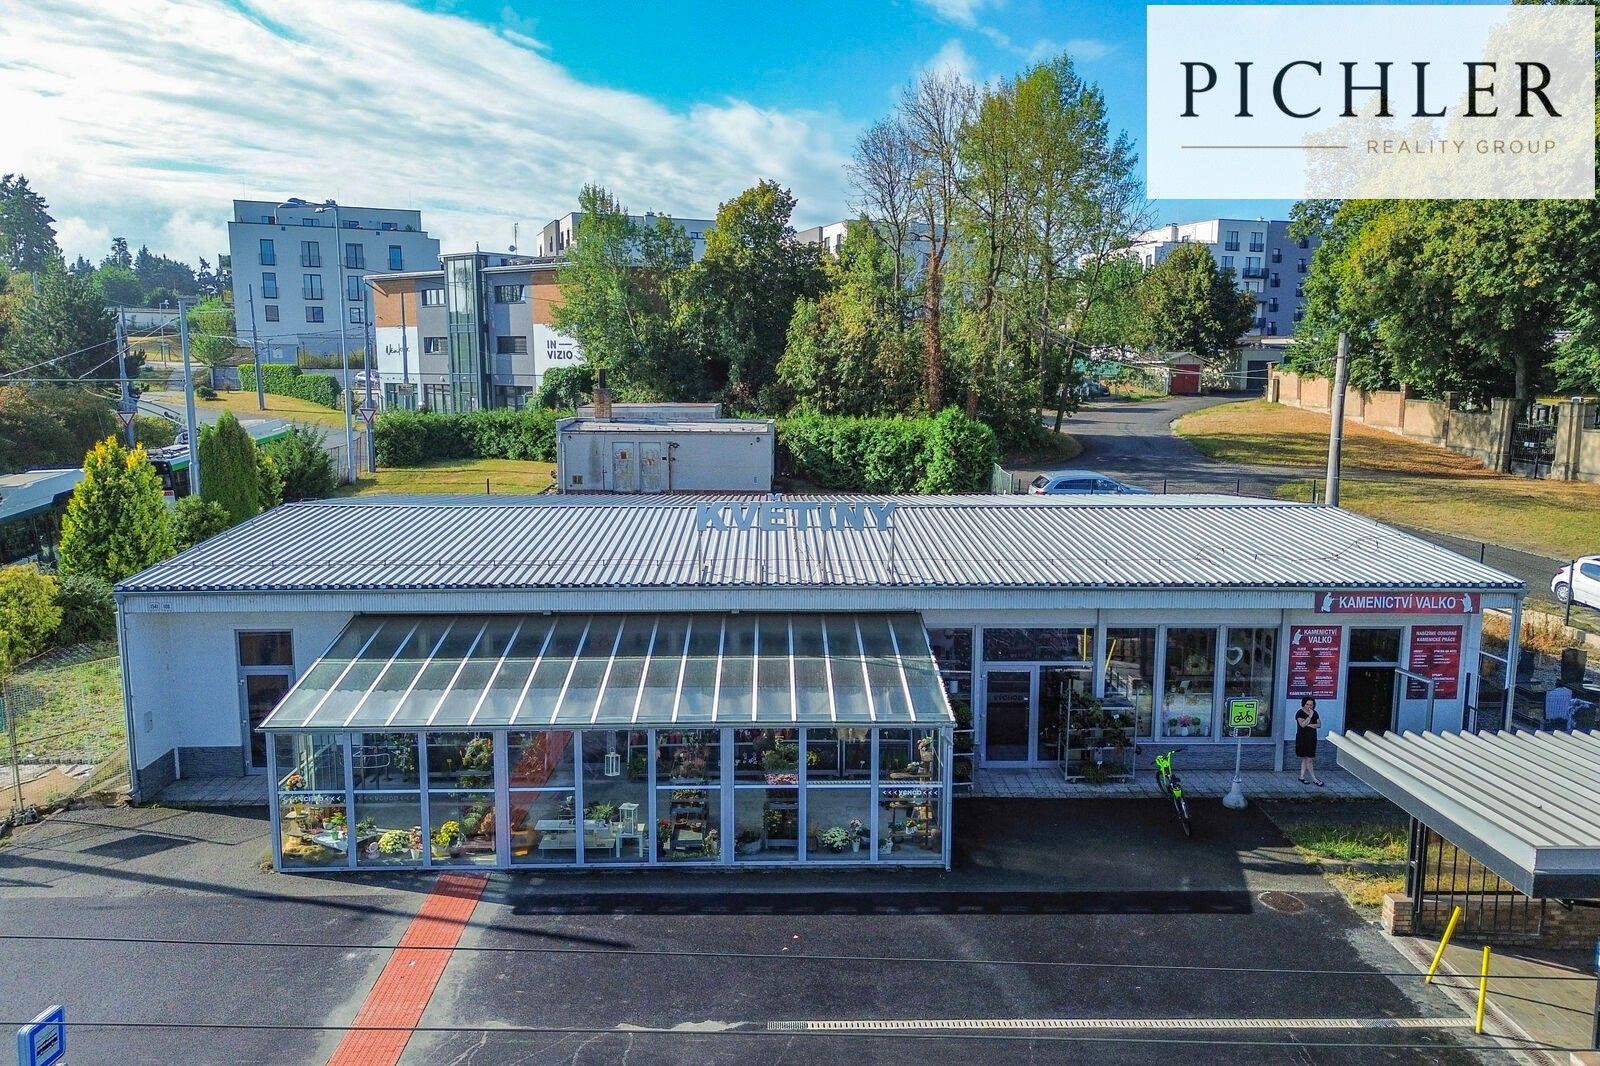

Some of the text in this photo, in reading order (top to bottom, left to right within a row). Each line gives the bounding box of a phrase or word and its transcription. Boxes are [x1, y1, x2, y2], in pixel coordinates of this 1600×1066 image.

[546, 340, 557, 349] IN
[547, 350, 573, 360] VIZIO
[1339, 593, 1456, 609] KAMENICTVÍ VALKO
[1303, 628, 1338, 636] KAMENICTVÍ
[1308, 636, 1332, 644] VALKO
